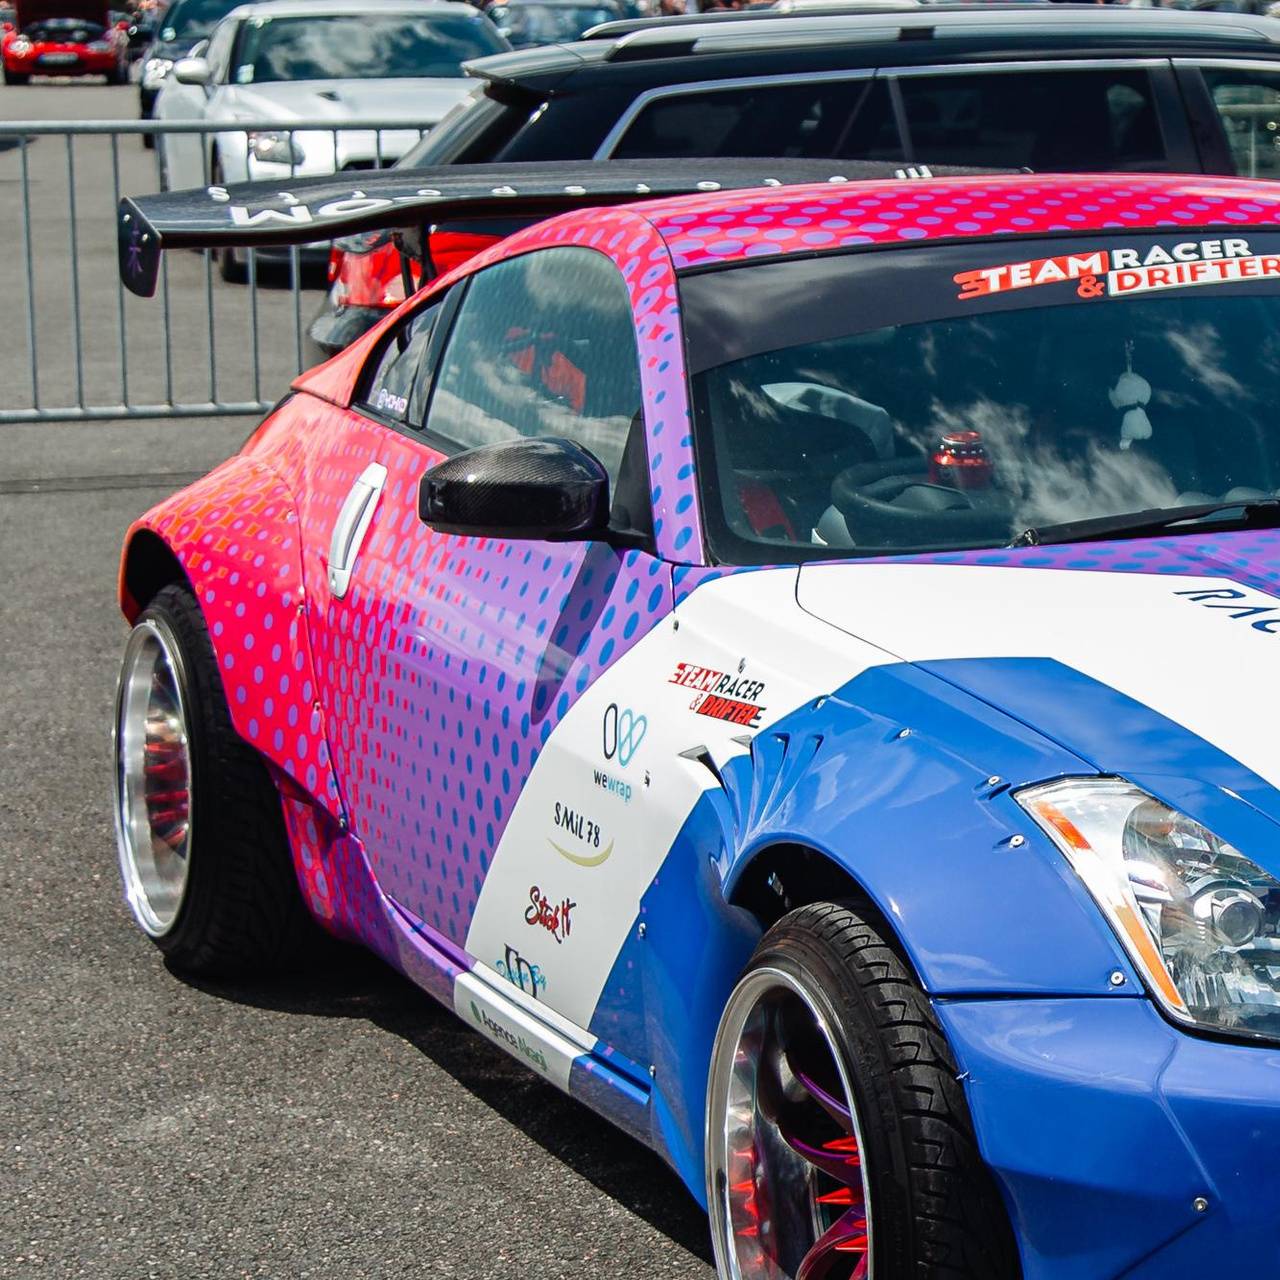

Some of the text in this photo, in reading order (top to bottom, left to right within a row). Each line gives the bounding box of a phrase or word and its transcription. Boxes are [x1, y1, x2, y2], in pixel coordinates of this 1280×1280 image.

[981, 238, 1252, 292] TEAM RACER
[1076, 274, 1105, 299] &
[677, 663, 765, 701] TEAM RACER
[689, 693, 760, 726] & DRIFTER
[593, 769, 632, 803] wewrap
[587, 820, 600, 848] 78
